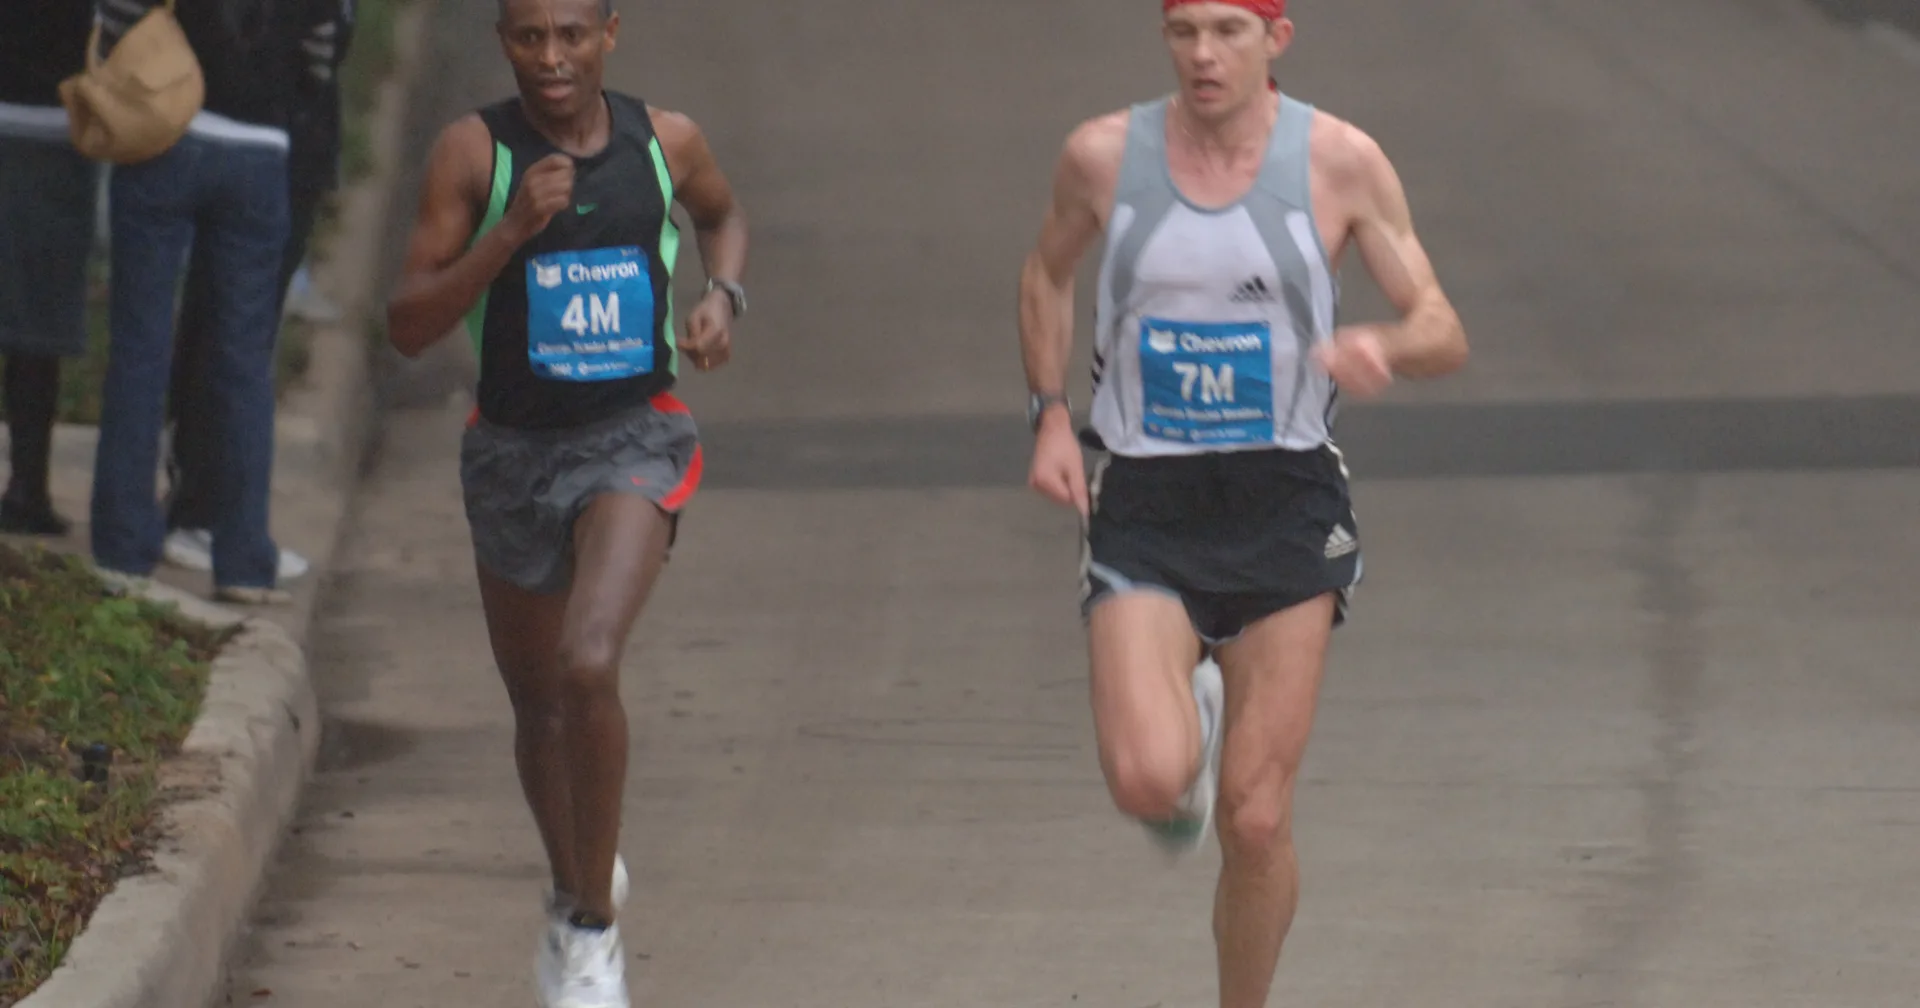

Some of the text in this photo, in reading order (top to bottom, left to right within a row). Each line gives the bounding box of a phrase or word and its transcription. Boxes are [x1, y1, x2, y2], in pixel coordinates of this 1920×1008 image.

[567, 261, 640, 283] Chevron
[561, 291, 620, 336] 4M
[1180, 332, 1262, 352] Chevron
[1172, 361, 1233, 404] 7M
